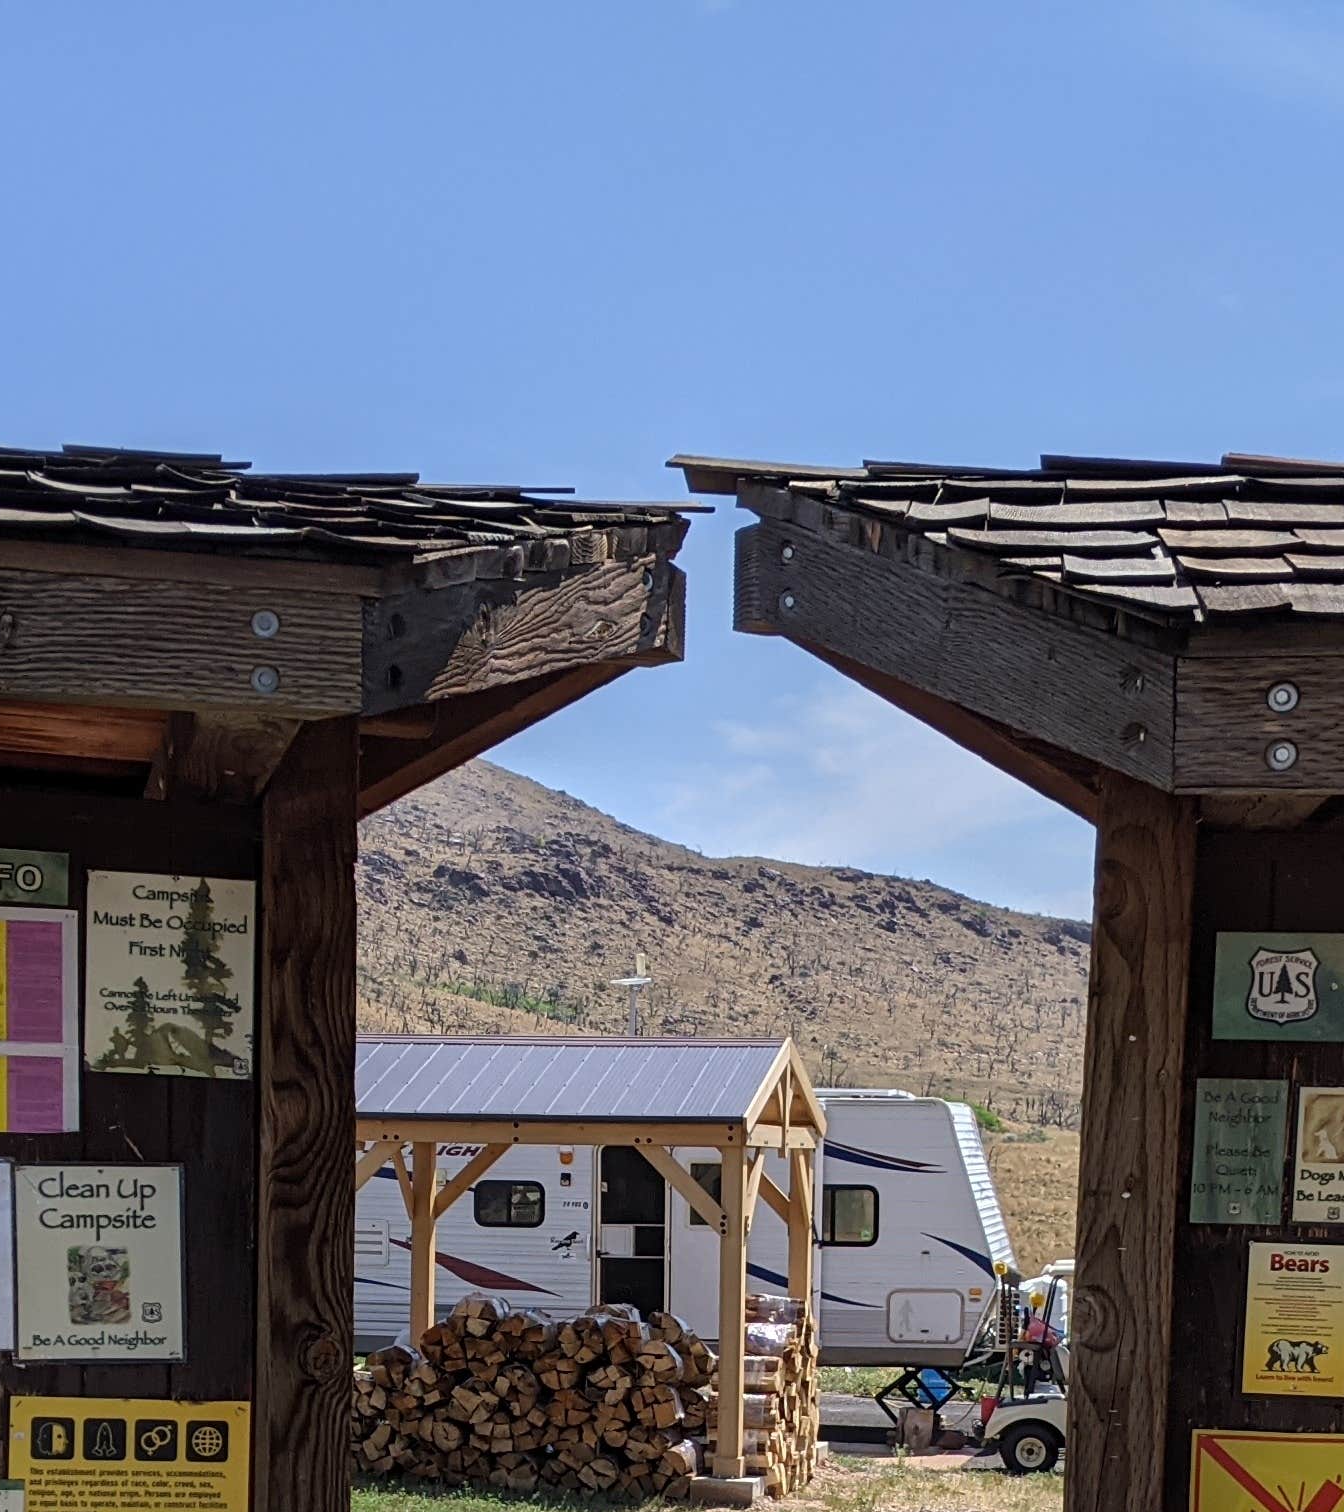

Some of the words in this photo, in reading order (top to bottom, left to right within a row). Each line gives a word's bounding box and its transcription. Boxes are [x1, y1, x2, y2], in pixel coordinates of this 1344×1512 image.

[133, 885, 209, 909] Campsi
[93, 910, 135, 926] Must
[139, 914, 162, 928] Be
[167, 915, 247, 939] Occupied
[129, 941, 165, 957] First
[156, 989, 177, 1001] Left
[1204, 1091, 1221, 1102] Be
[1226, 1092, 1235, 1102] A
[1241, 1090, 1280, 1104] Good
[1209, 1109, 1272, 1128] Neighbor
[1300, 1170, 1335, 1185] Dogs
[38, 1171, 109, 1199] Clean
[117, 1178, 156, 1211] Up
[1296, 1190, 1313, 1201] Be
[39, 1207, 156, 1241] Campsite
[1270, 1254, 1329, 1273] Bears
[33, 1334, 51, 1346] Be
[53, 1335, 66, 1346] A
[68, 1330, 105, 1346] Good
[108, 1330, 167, 1350] Neighbor
